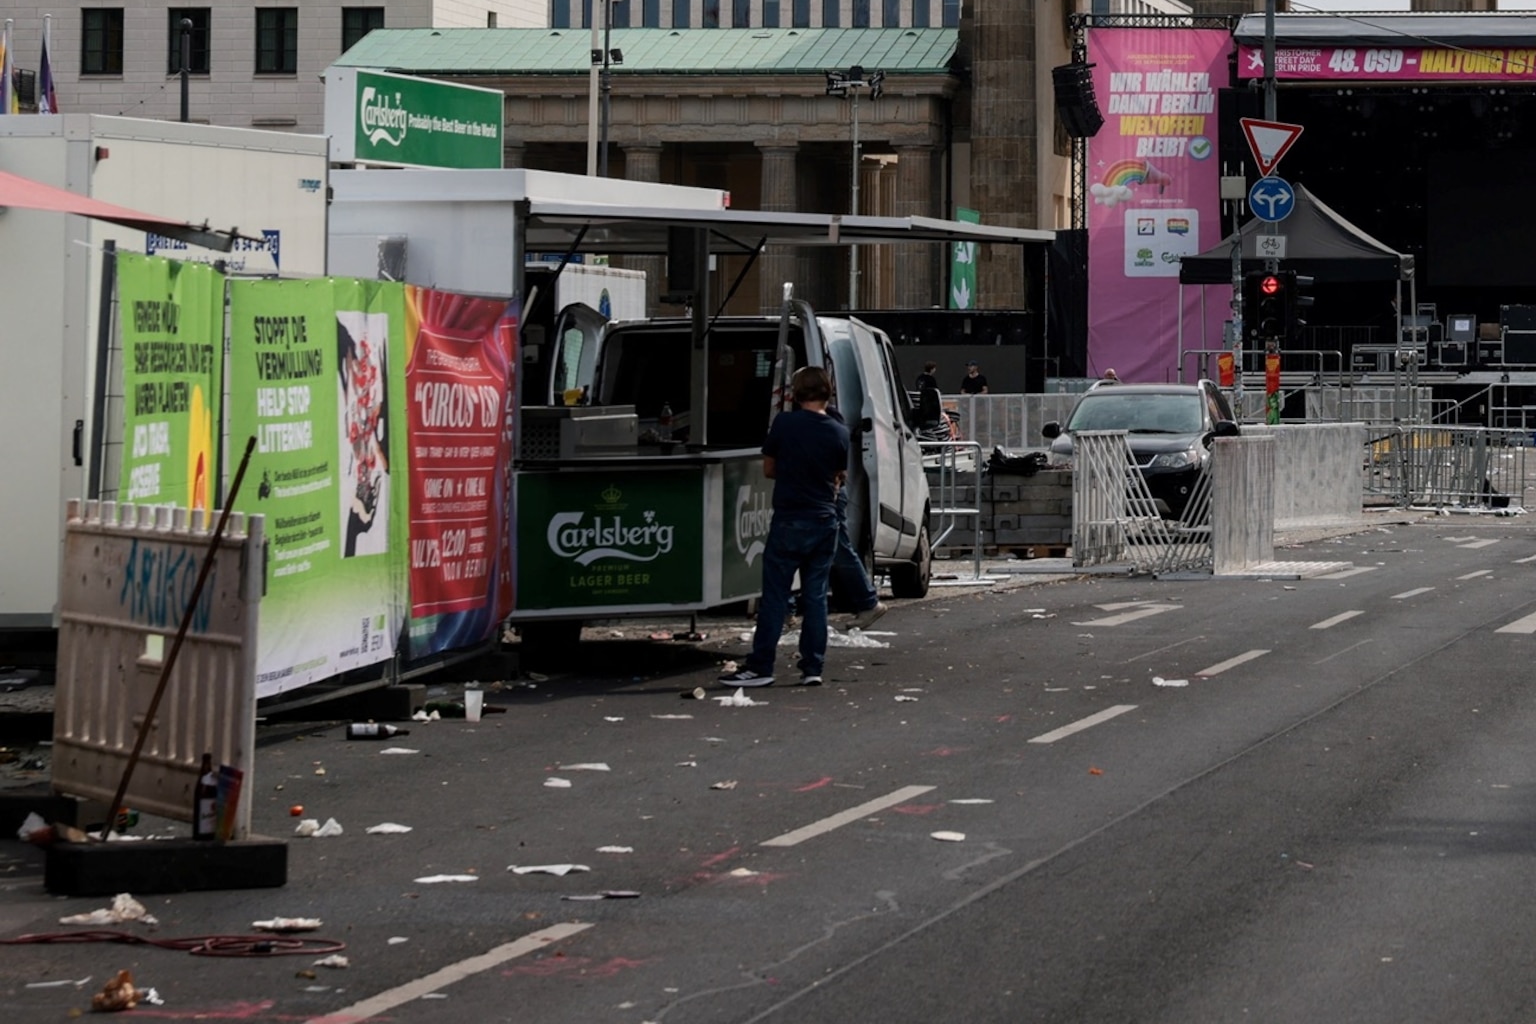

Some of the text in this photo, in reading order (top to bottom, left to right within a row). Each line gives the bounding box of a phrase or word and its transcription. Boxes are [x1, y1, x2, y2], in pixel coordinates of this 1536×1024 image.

[1298, 63, 1322, 72] PRIDE
[1300, 56, 1316, 64] DAY
[1329, 49, 1360, 72] 48.
[1364, 49, 1404, 72] CSD
[1419, 49, 1503, 73] HALTUNG
[1110, 68, 1213, 96] WIR WÄHLEN,
[1108, 94, 1215, 114] DAMIT BERLIN
[361, 86, 408, 147] Carlsberg
[432, 116, 442, 131] the
[442, 118, 454, 133] Best
[454, 119, 467, 134] Beer
[473, 121, 481, 136] the
[481, 123, 497, 139] World
[1120, 115, 1206, 136] WELTOFFEN
[1135, 137, 1188, 157] BLEIBT
[291, 316, 307, 343] DIE
[257, 385, 310, 416] HELP STOP
[442, 528, 466, 559] 12:00
[547, 510, 675, 567] Carlsberg
[570, 574, 650, 588] LAGER BEER
